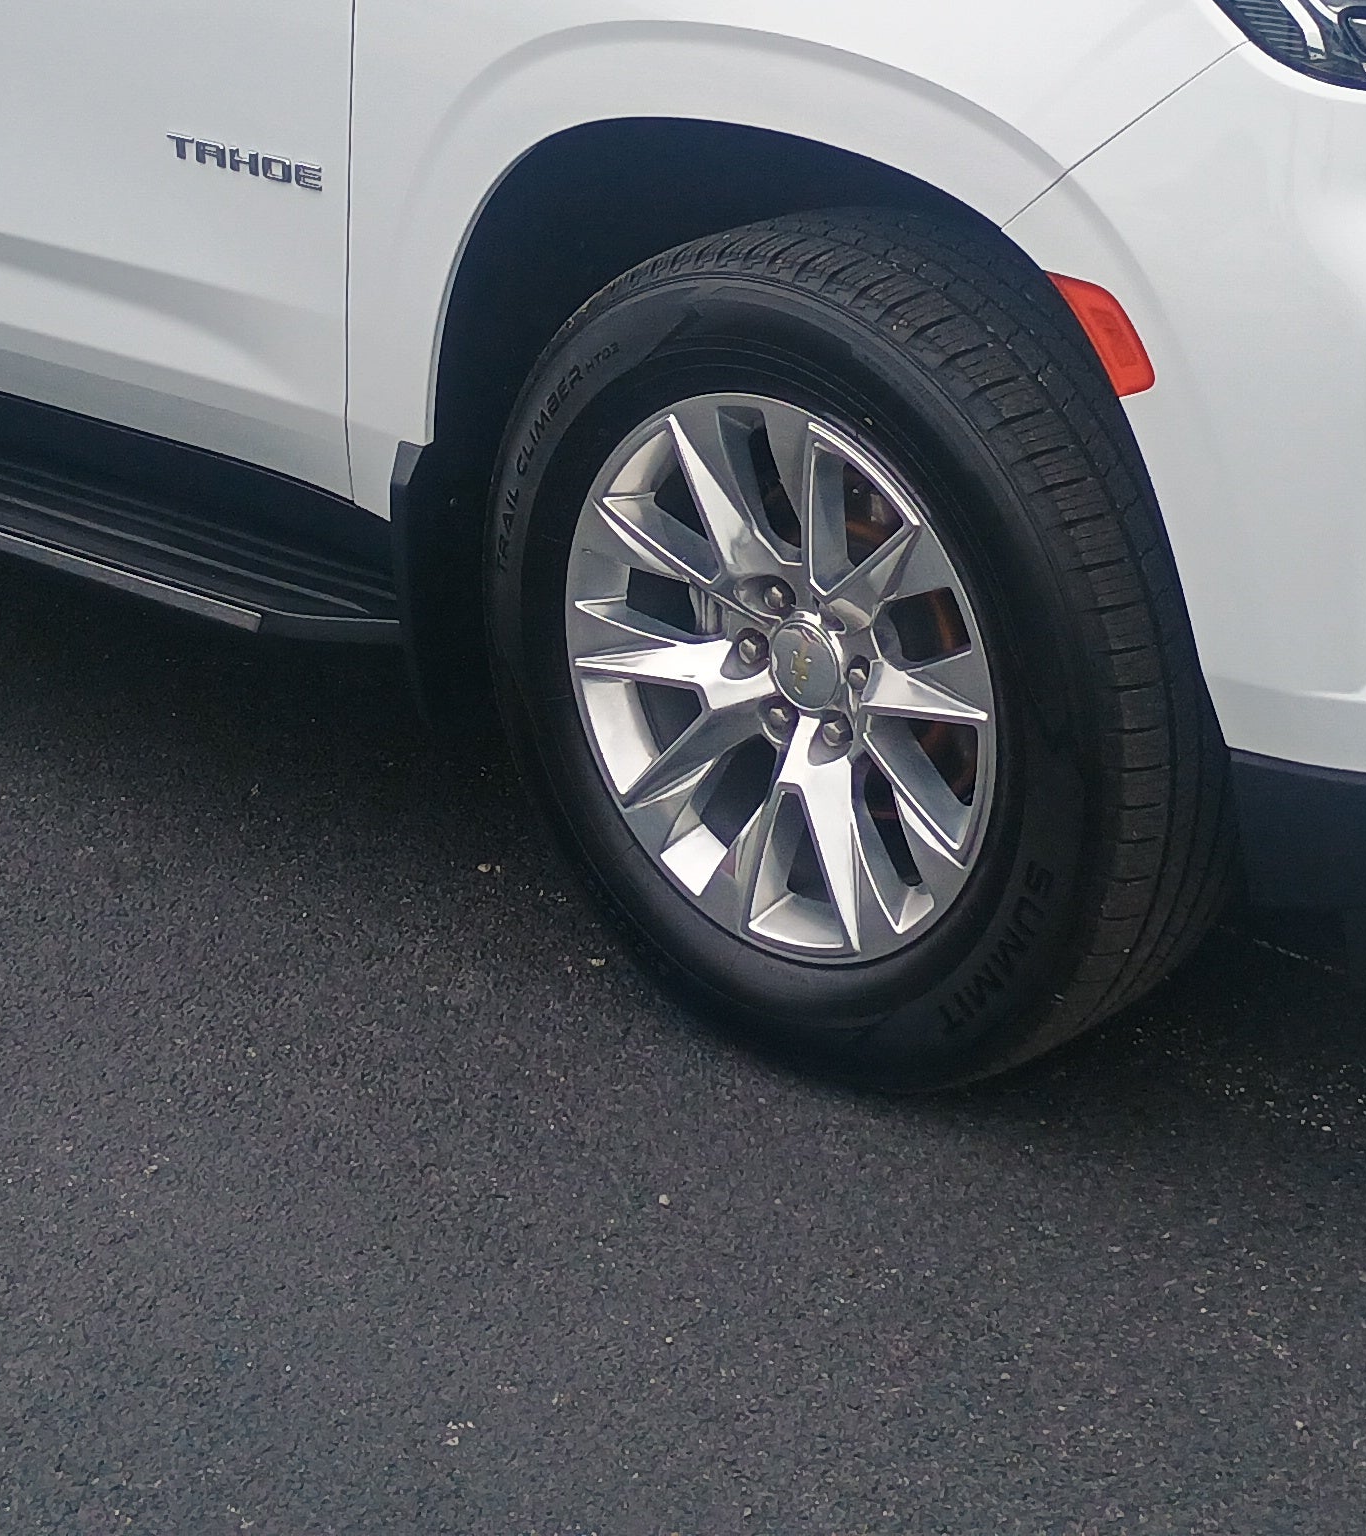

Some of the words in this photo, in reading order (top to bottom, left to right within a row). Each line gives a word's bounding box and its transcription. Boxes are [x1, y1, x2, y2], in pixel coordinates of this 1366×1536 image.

[166, 131, 323, 192] TAHOE
[497, 487, 521, 572] TRAIL
[516, 364, 585, 477] CLIMBER
[937, 860, 1054, 1031] SUMMIT
